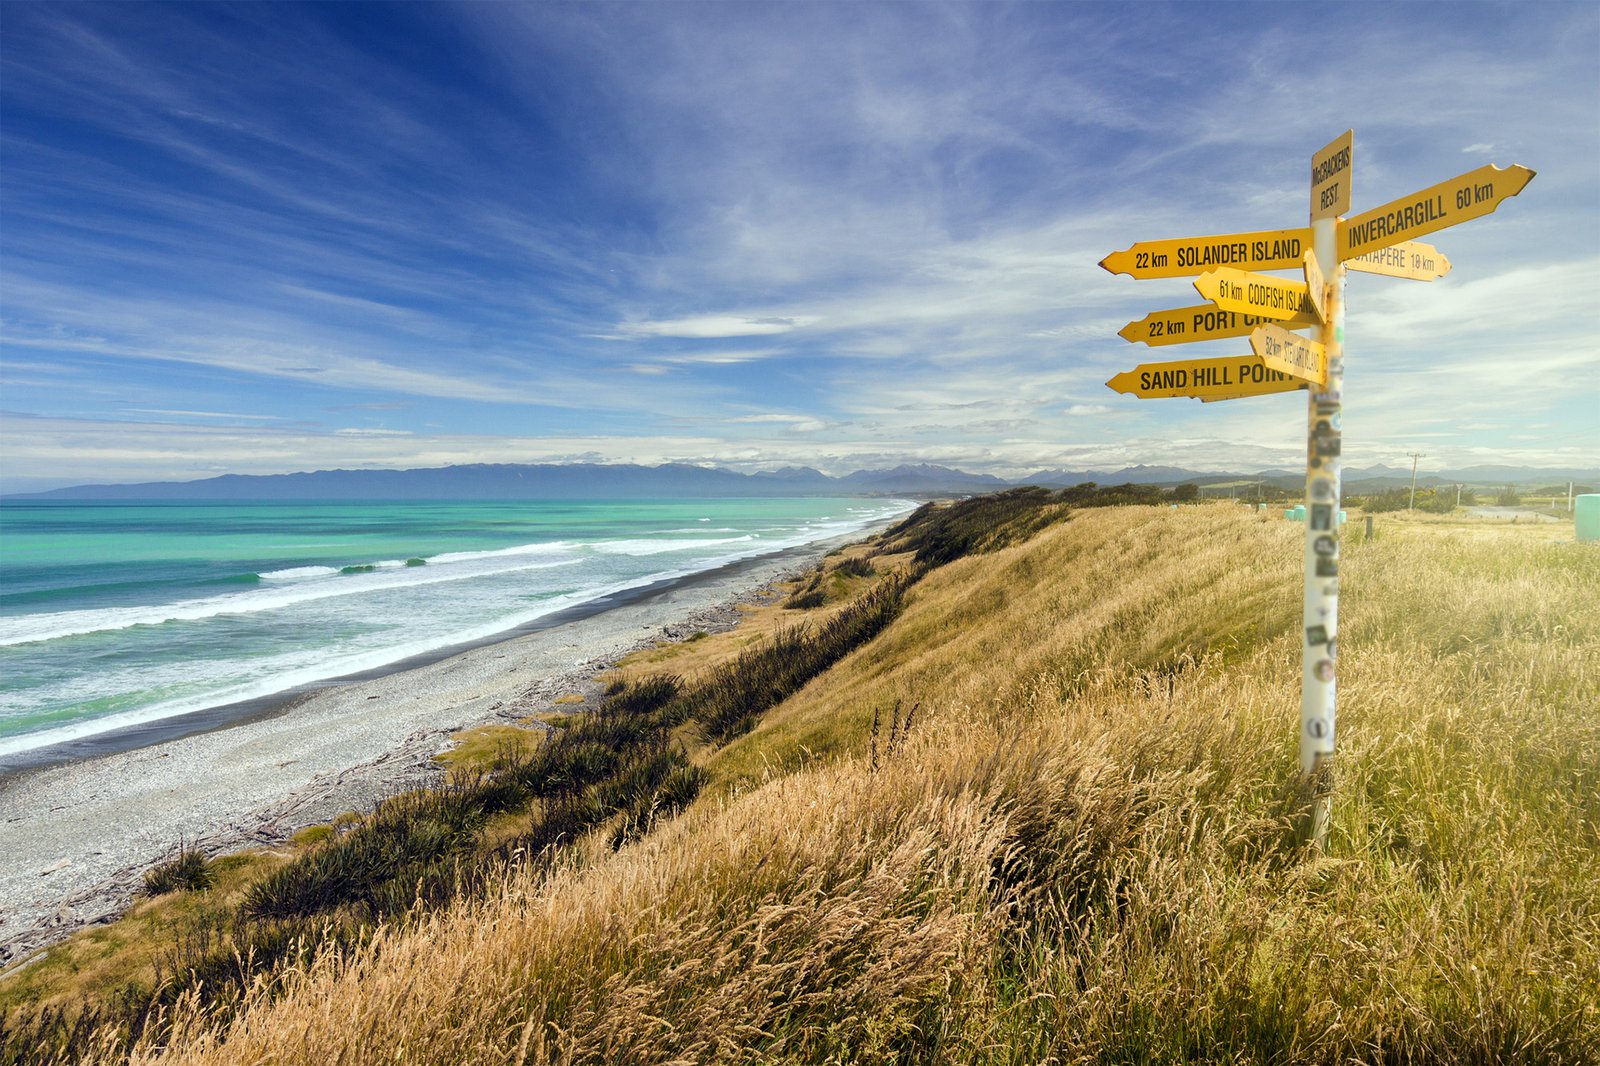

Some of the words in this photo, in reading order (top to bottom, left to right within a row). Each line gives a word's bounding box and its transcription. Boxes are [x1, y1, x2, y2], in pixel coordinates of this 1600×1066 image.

[1321, 183, 1338, 211] REST
[1349, 196, 1447, 248] INVERCARGILL
[1456, 187, 1471, 210] 60
[1474, 183, 1493, 204] km
[1136, 253, 1149, 269] 22
[1152, 252, 1168, 267] km
[1177, 243, 1247, 267] SOLANDER
[1252, 238, 1300, 262] ISLAND
[1422, 255, 1434, 272] km
[1220, 280, 1229, 298] 61
[1231, 282, 1242, 300] km
[1248, 283, 1284, 309] CODFISH
[1286, 290, 1314, 314] ISLAND
[1149, 321, 1163, 337] 22
[1167, 320, 1185, 335] km
[1193, 311, 1236, 333] PORT
[1141, 369, 1187, 390] SAND
[1193, 366, 1233, 387] HILL
